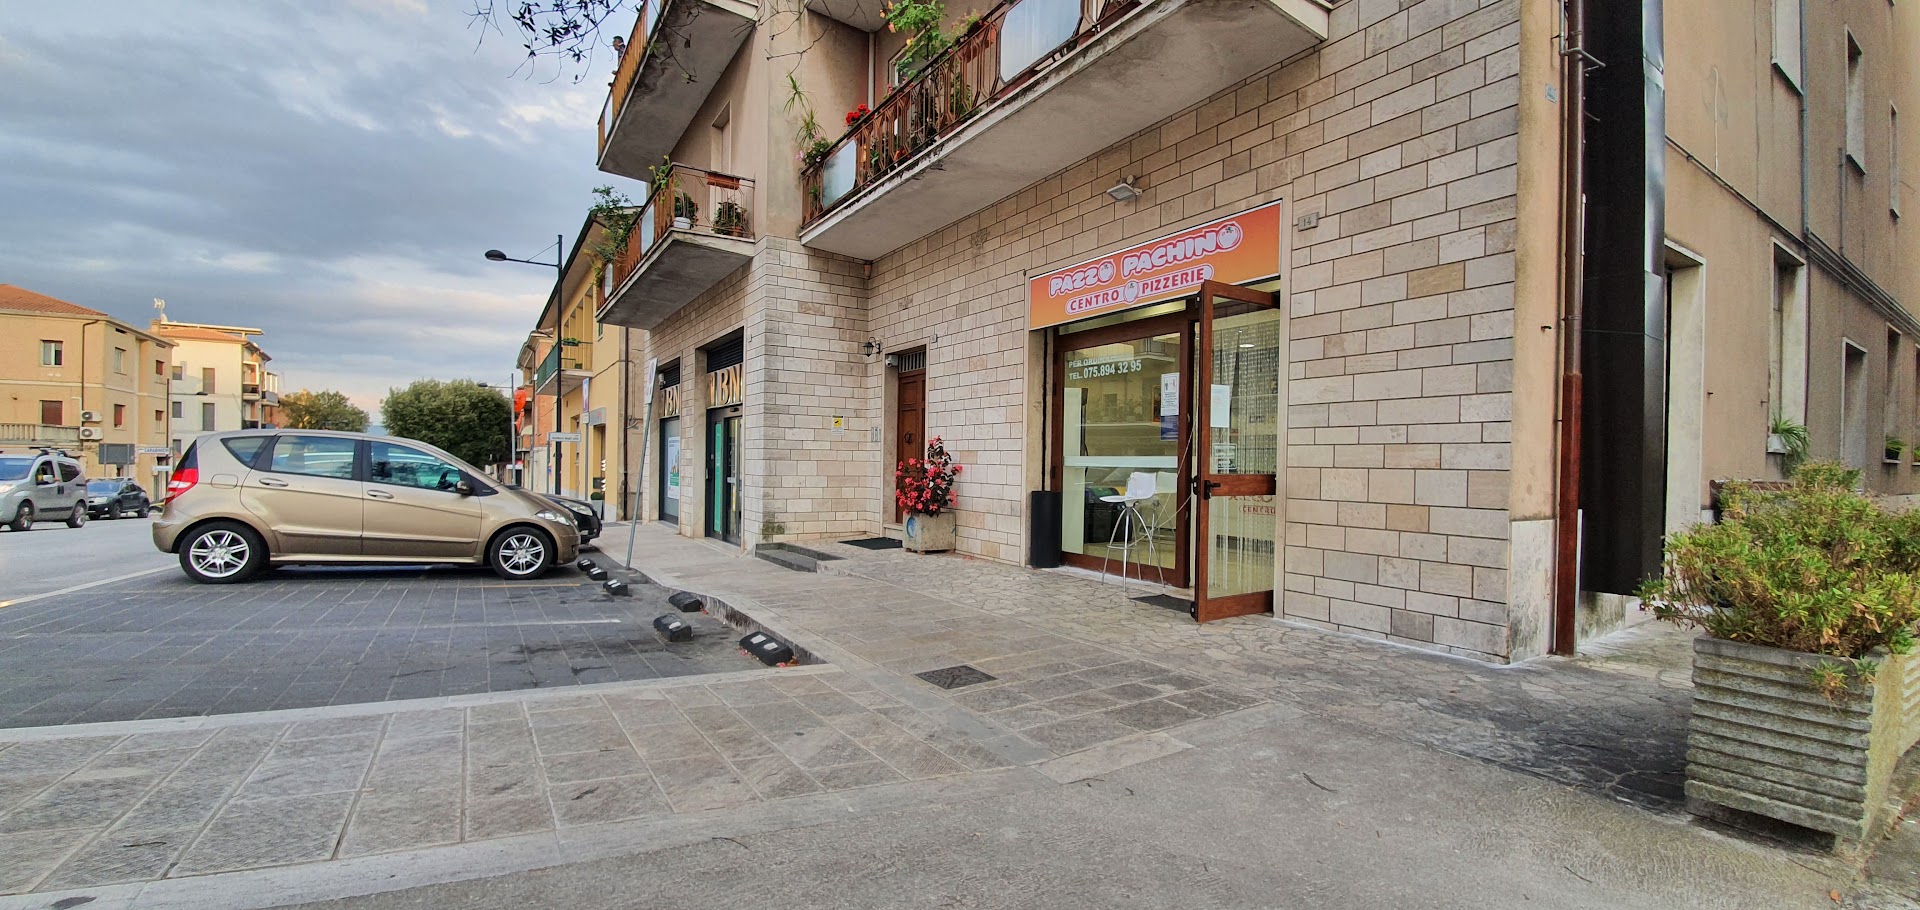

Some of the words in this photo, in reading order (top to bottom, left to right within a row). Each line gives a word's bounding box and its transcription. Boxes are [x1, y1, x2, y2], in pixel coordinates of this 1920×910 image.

[1050, 261, 1115, 296] PAZZO
[1122, 223, 1241, 277] PACHINO
[1070, 290, 1119, 311] CENTRO
[1142, 268, 1204, 294] PIZZERIE
[1069, 372, 1083, 380] TEL.
[1083, 363, 1115, 378] 075.894
[1117, 361, 1128, 374] 32
[1130, 360, 1142, 372] 95
